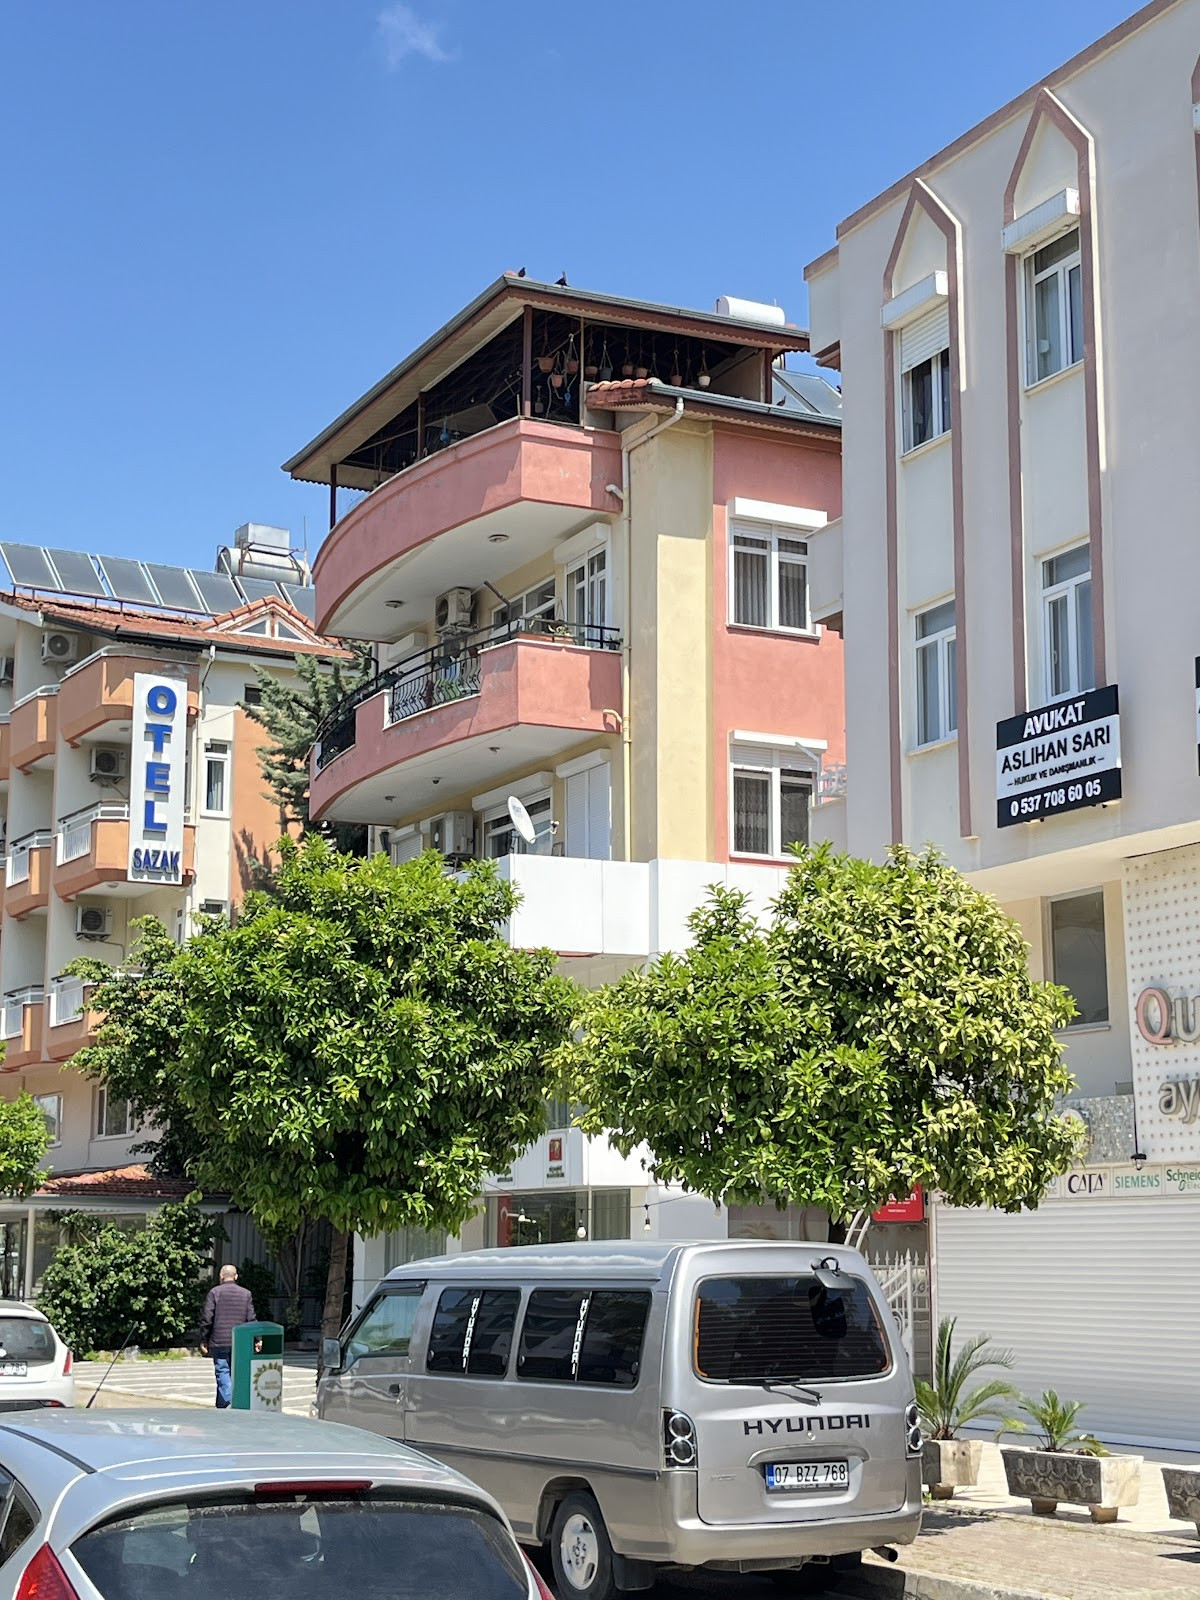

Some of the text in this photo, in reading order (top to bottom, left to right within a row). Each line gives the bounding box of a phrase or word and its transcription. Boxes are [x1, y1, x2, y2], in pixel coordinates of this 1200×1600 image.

[1023, 701, 1085, 738] AVUKAT
[144, 685, 178, 832] OTEL
[1001, 725, 1110, 773] ASLIHAN SARI
[1014, 772, 1037, 786] HUKUK
[1039, 769, 1048, 779] VE
[1010, 779, 1101, 817] 0 537 708 60 05
[133, 848, 180, 874] SAZAK
[1068, 1173, 1103, 1194] CATA
[1115, 1174, 1160, 1189] SIEMENS
[462, 1297, 480, 1368] HYUNDAI
[571, 1298, 589, 1375] HYUNDAI
[743, 1414, 871, 1436] HYUNDAI
[775, 1464, 845, 1483] 07 BZZ 768
